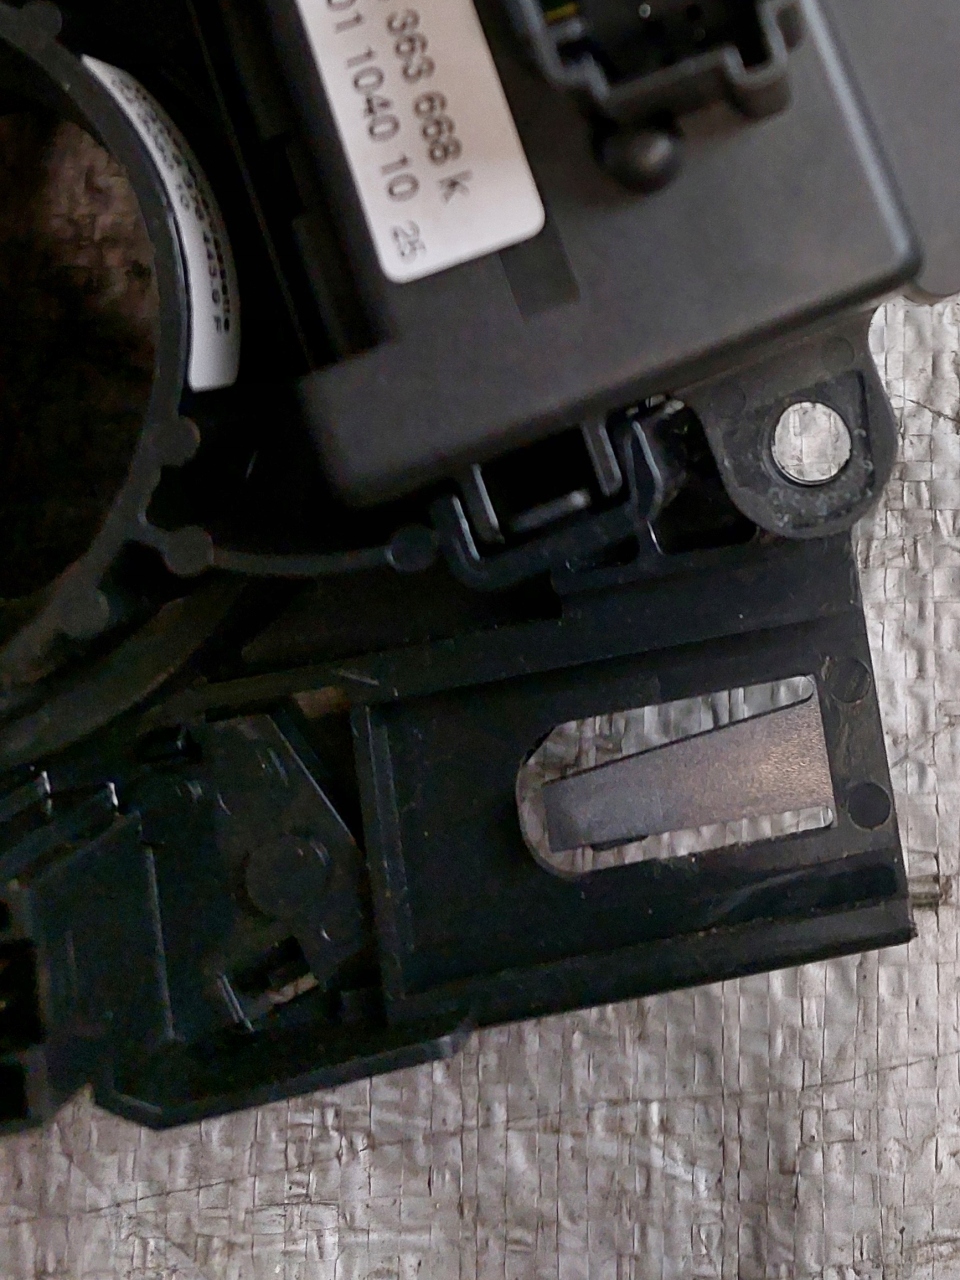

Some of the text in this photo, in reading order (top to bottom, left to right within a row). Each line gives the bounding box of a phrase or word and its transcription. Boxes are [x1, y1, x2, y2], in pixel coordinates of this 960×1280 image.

[346, 46, 400, 143] 1040
[380, 155, 420, 204] 10
[386, 9, 435, 85] 363
[413, 90, 463, 167] 668
